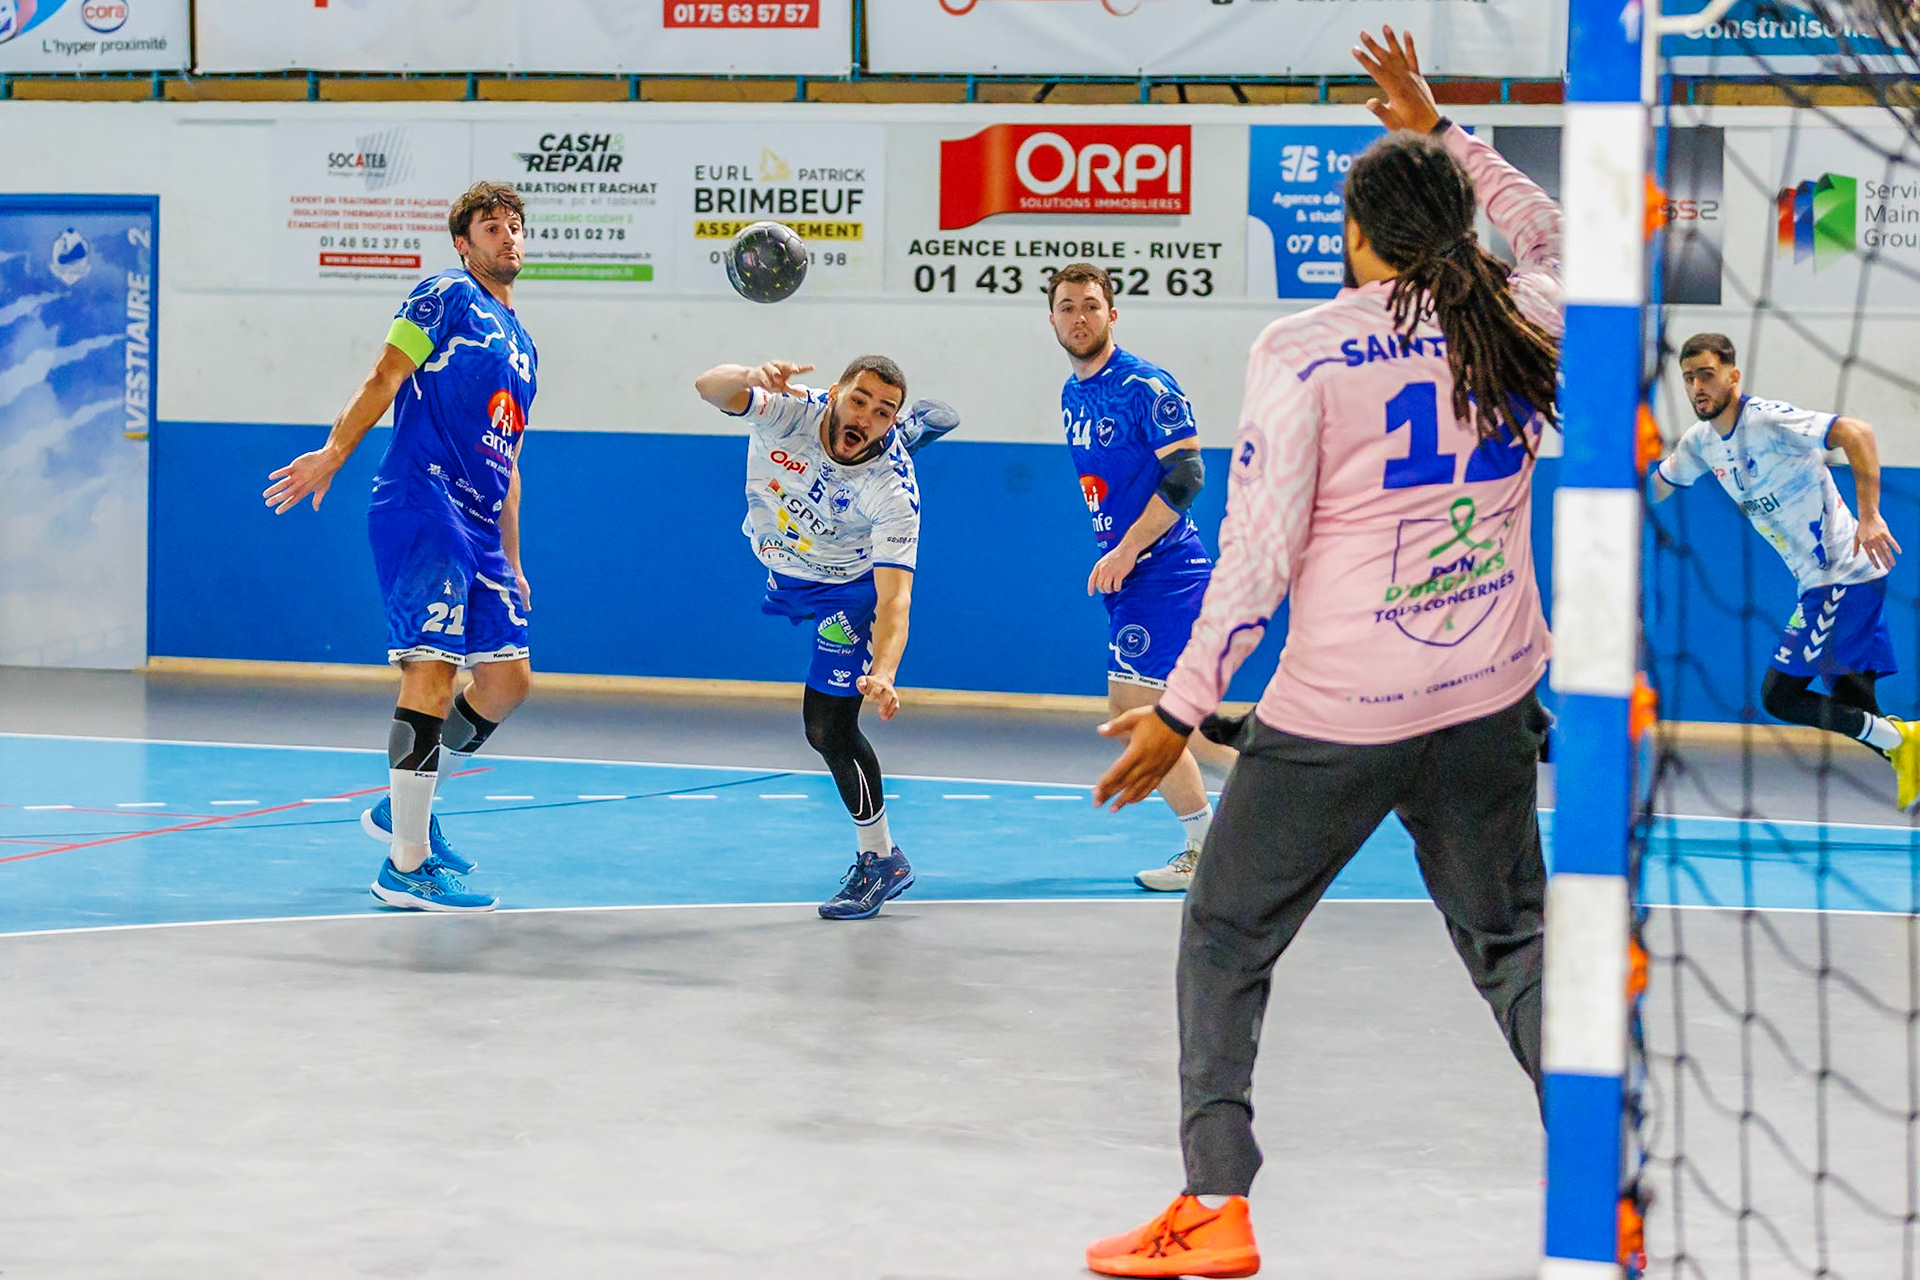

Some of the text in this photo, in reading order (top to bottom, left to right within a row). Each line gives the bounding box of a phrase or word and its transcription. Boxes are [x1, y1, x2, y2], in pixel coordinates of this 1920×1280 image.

[83, 5, 125, 19] cora
[673, 4, 810, 23] 01 75 63 57 57
[43, 36, 168, 55] L'hyper proximité
[526, 154, 623, 172] REPAIR
[1325, 150, 1352, 174] to
[695, 165, 866, 182] EURL PATRICK
[581, 183, 595, 193] ET
[600, 183, 658, 193] RACHAT
[1865, 180, 1920, 199] Servi
[694, 188, 864, 214] BRIMBEUF
[1020, 197, 1092, 209] SOLUTIONS
[1272, 191, 1341, 208] Agence de
[541, 228, 559, 240] 43
[565, 228, 580, 240] 01
[585, 229, 603, 240] 02
[608, 229, 626, 240] 78
[696, 222, 862, 238] ASSAEMENT
[1864, 228, 1920, 247] Grou
[320, 236, 334, 247] 01
[362, 237, 378, 248] 52
[383, 238, 399, 248] 37
[908, 239, 1005, 257] AGENCE
[1015, 241, 1125, 258] LENOBLE
[1150, 242, 1222, 260] RIVET
[1287, 234, 1344, 254] 07 80
[823, 252, 847, 266] 98
[914, 264, 957, 294] 01
[975, 265, 1023, 294] 43
[1166, 268, 1213, 297] 63
[125, 228, 150, 430] VESTIAIRE 2
[1341, 333, 1447, 367] SAINT
[1072, 419, 1092, 449] 14
[770, 450, 808, 474] Orpi
[422, 601, 465, 636] 21
[836, 610, 860, 645] MERLIN
